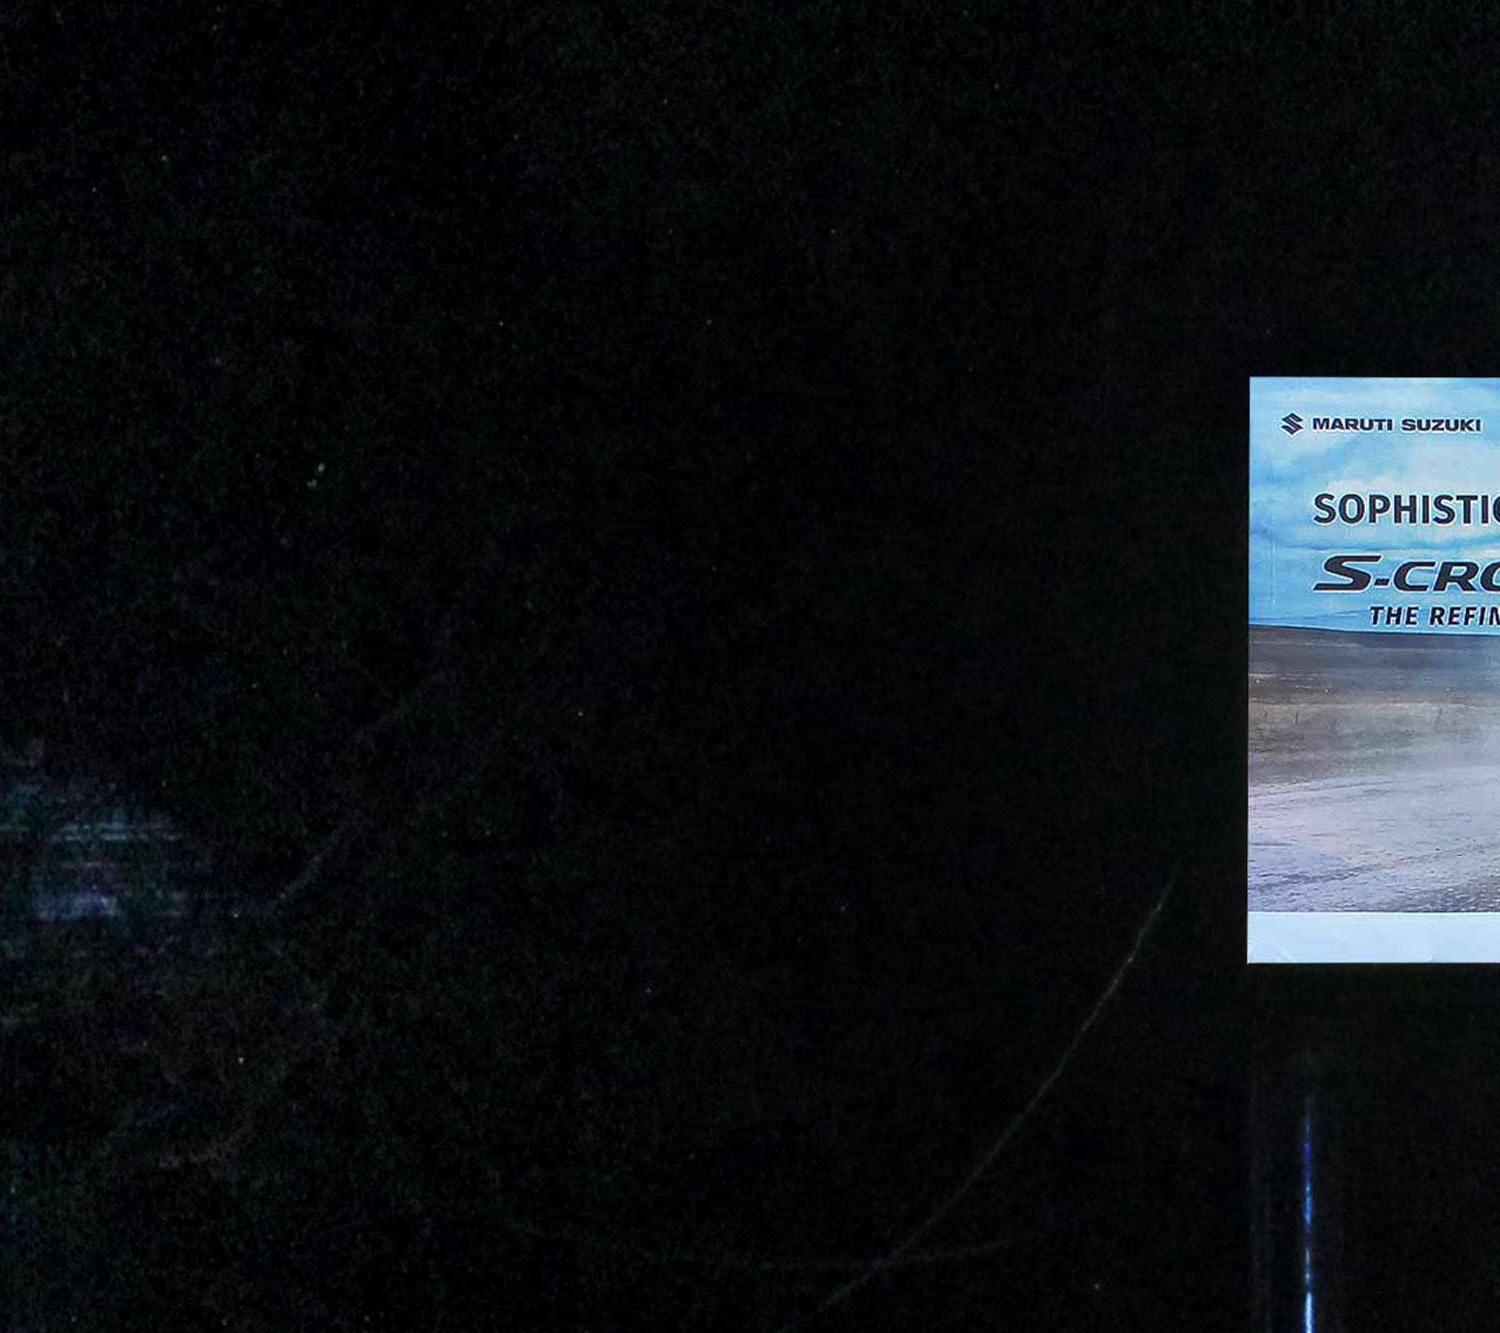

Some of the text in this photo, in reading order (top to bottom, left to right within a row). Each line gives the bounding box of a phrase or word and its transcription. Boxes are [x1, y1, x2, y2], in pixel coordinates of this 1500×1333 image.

[1312, 417, 1481, 432] MARUTI SUZUKI
[1370, 606, 1417, 626] THE
